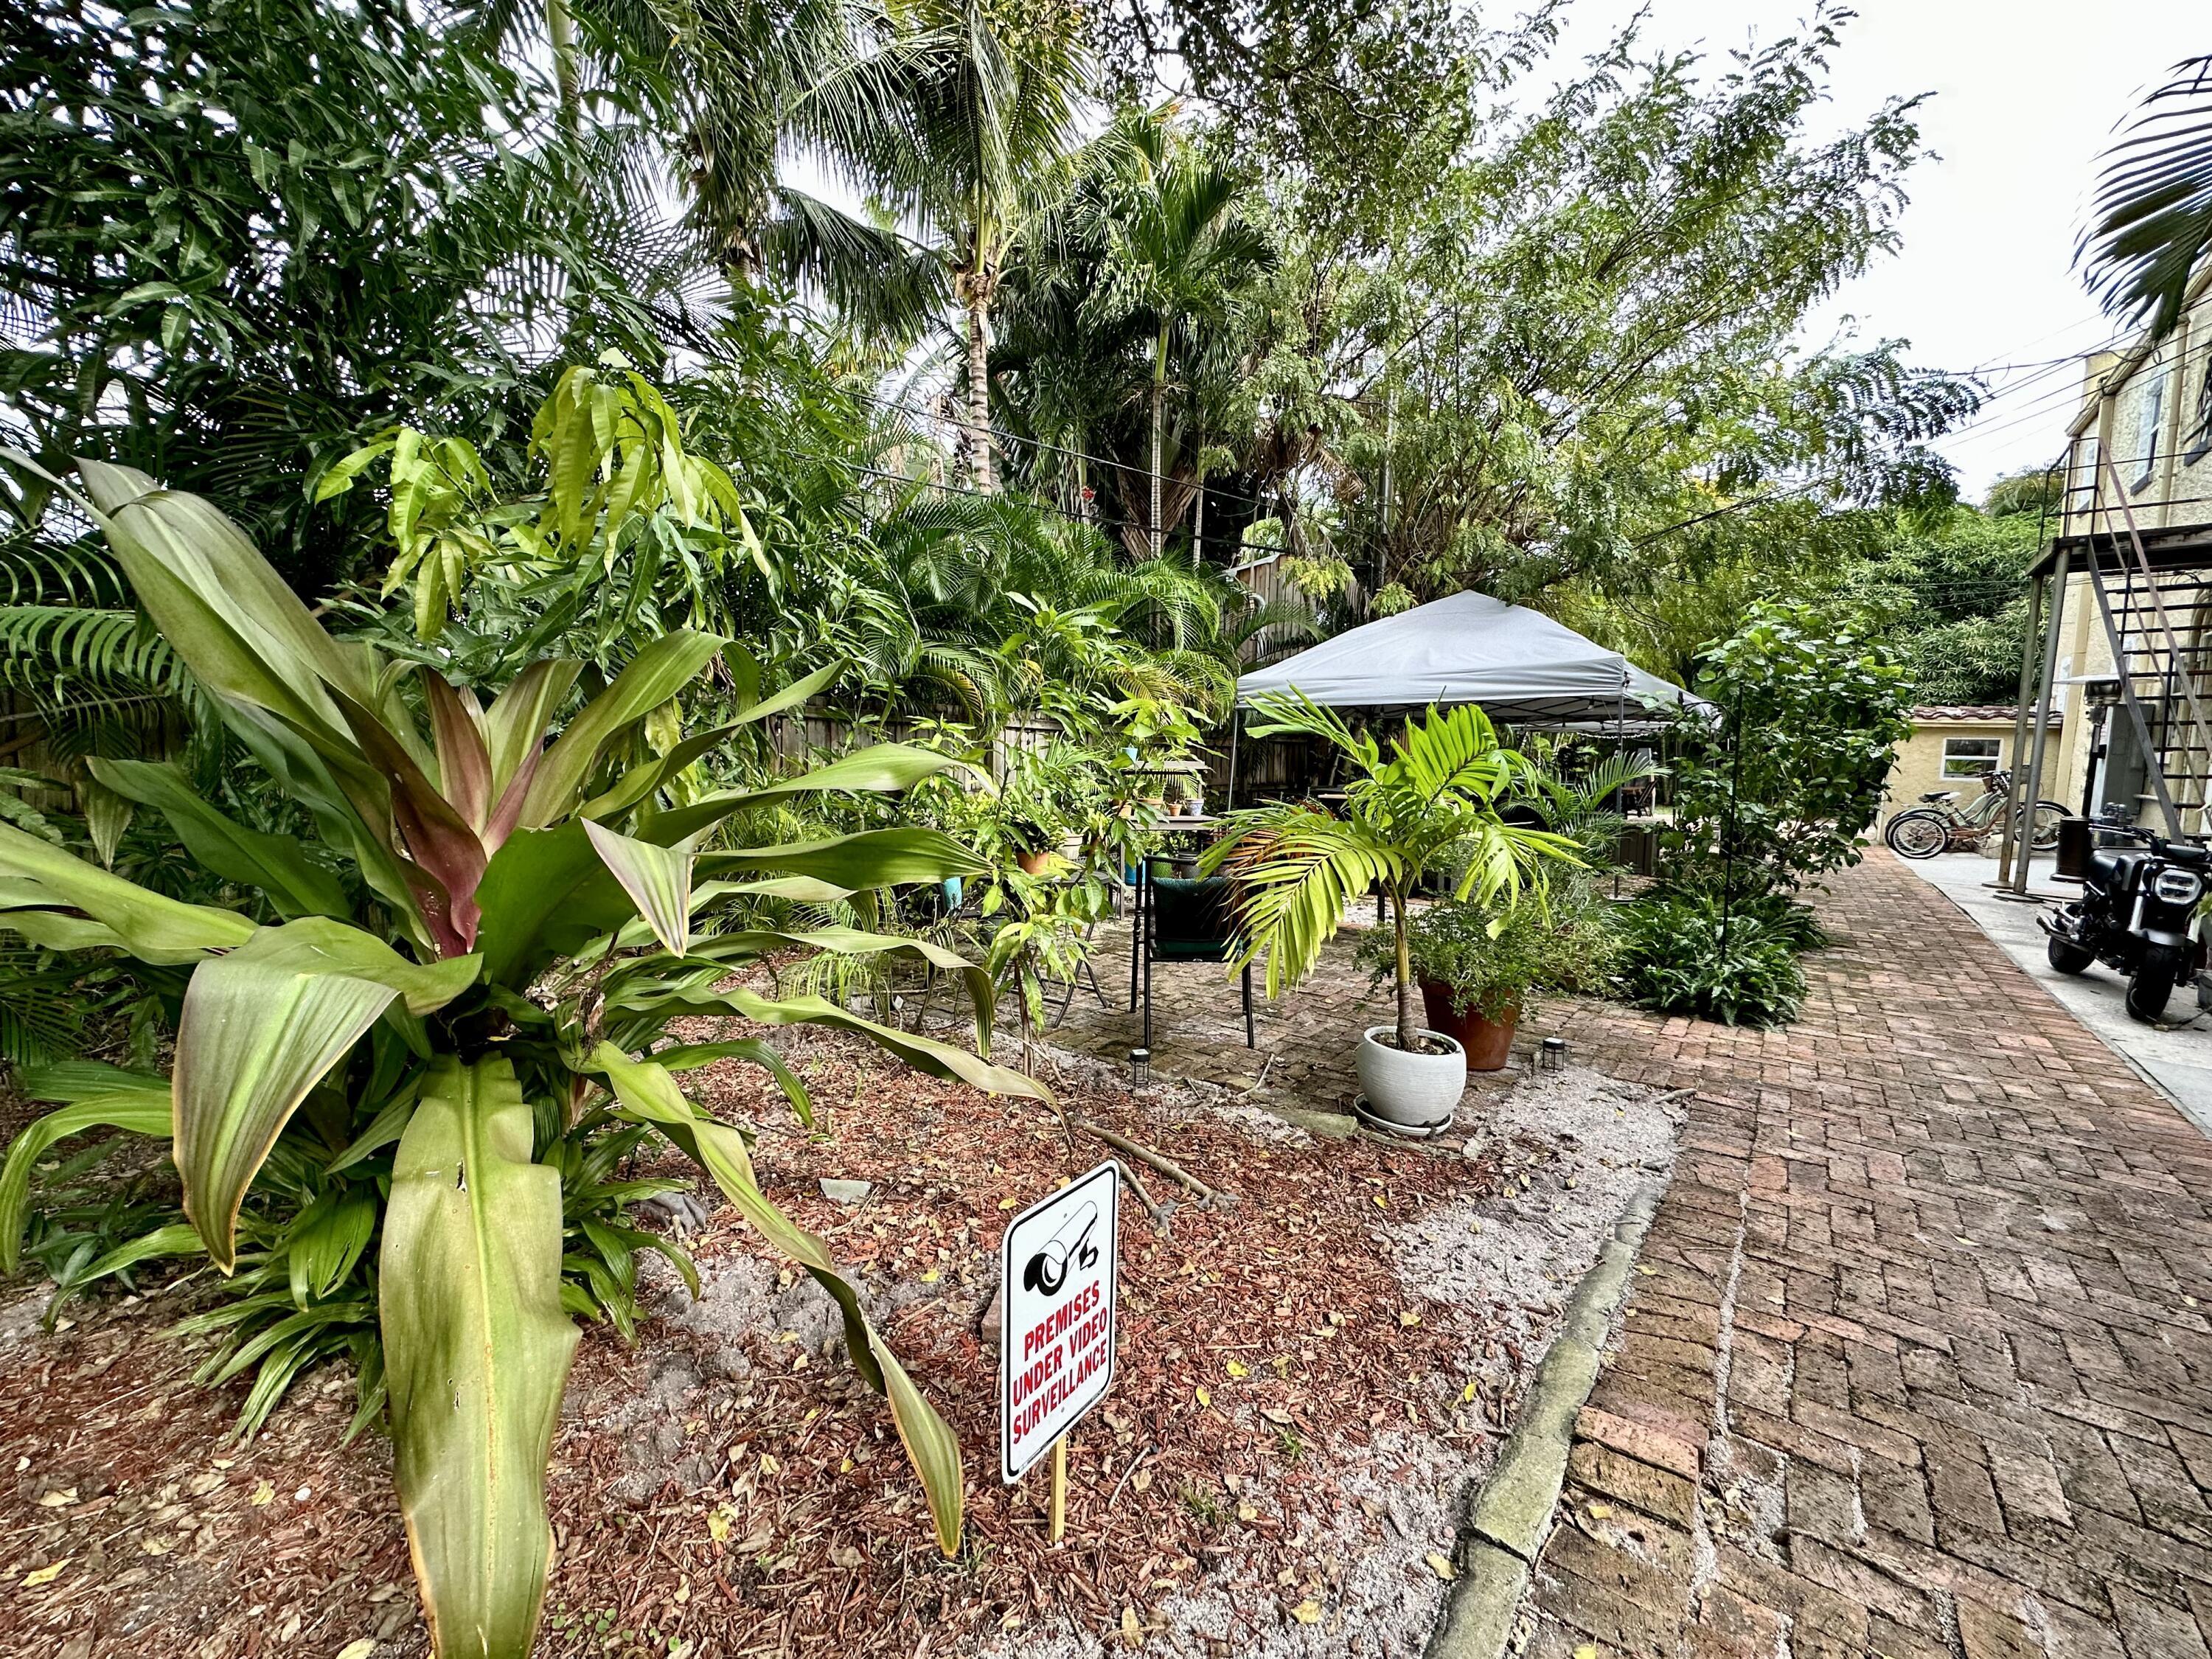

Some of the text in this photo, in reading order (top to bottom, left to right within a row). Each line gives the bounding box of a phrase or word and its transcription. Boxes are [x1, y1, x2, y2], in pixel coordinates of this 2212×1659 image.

[1013, 1344, 1063, 1407] UNDER
[1069, 1308, 1107, 1357] VIDEO
[1024, 1280, 1100, 1361] PREMISES
[1013, 1340, 1107, 1444] SURVEILLANCE
